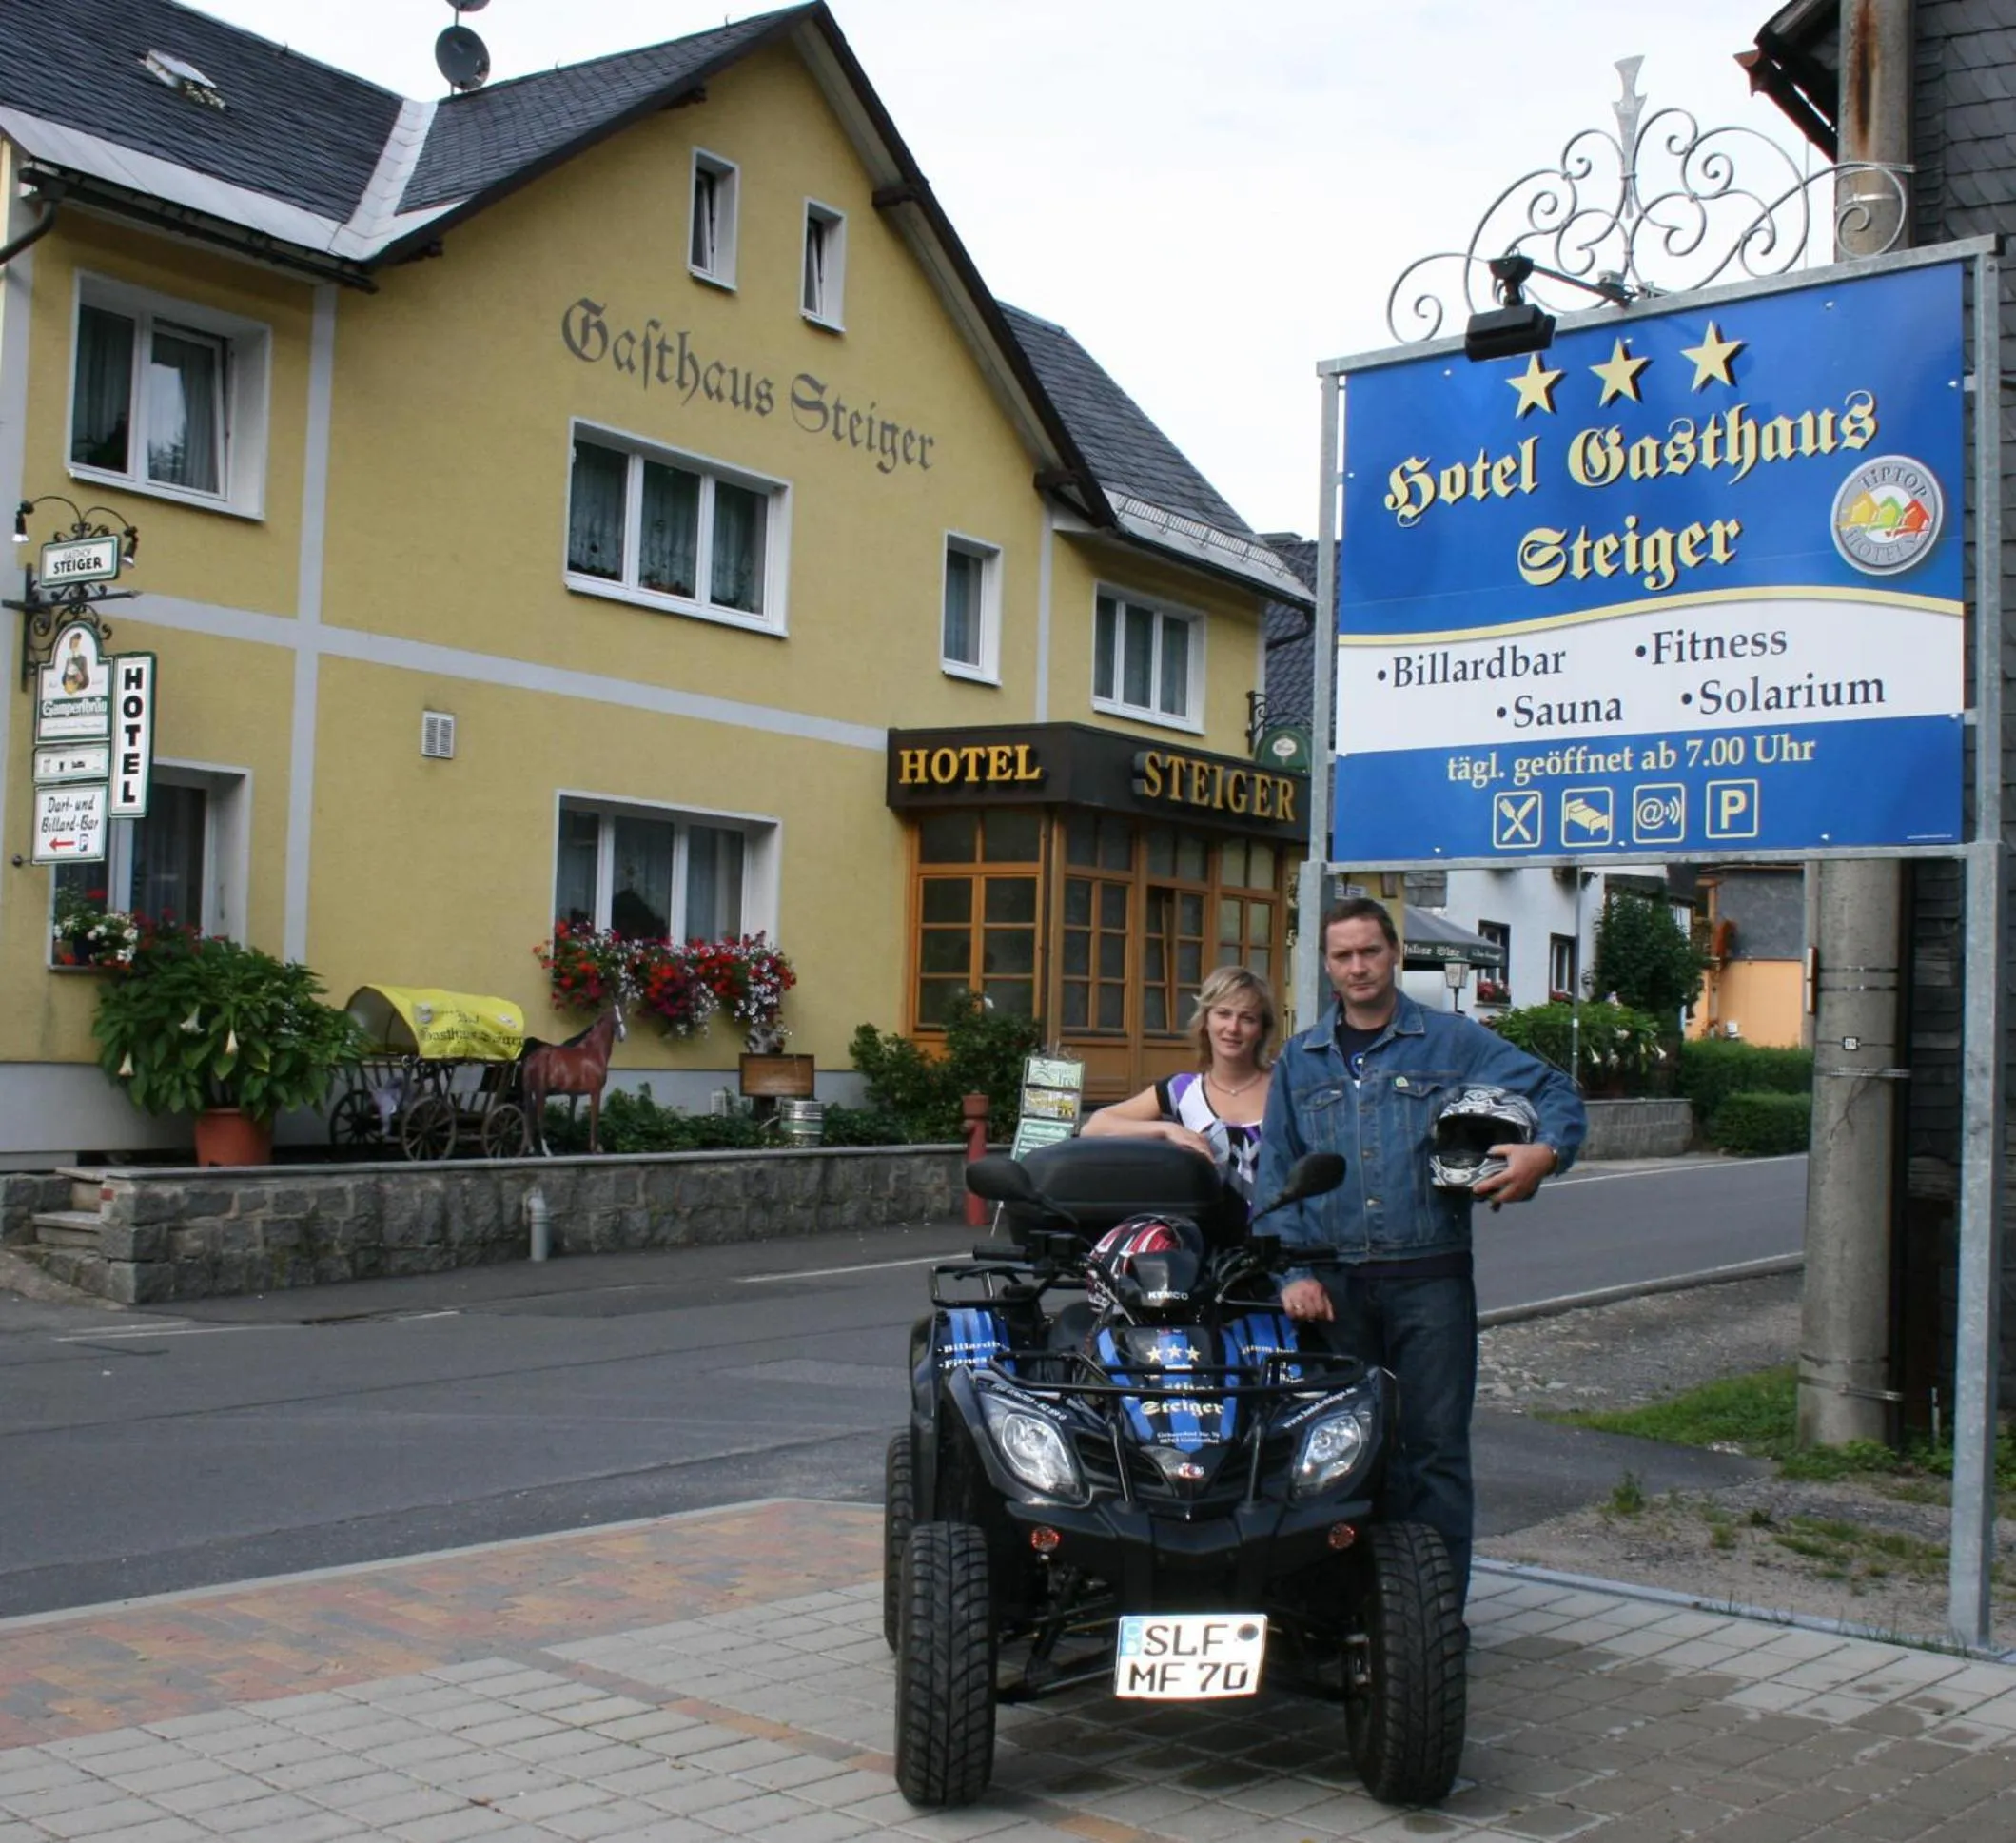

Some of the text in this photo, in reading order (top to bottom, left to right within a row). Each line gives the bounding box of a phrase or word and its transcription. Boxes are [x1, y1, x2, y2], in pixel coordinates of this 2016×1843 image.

[790, 373, 934, 474] Steiger
[1383, 388, 1878, 528] Hotel Gasthaus
[53, 556, 103, 575] STEIGER
[1517, 514, 1743, 592] Steiger
[1392, 628, 1789, 690] Billardbar Fitness
[1513, 672, 1887, 729] Sauna Solarium
[123, 667, 144, 803] HOTEL
[1446, 735, 1816, 789] tägl. geöffnet ab 7.00 Uhr
[898, 743, 1296, 822] HOTEL STEIGER
[1141, 1393, 1224, 1417] Steiger
[1144, 1623, 1230, 1657] SLF
[1128, 1661, 1249, 1693] MF 70
